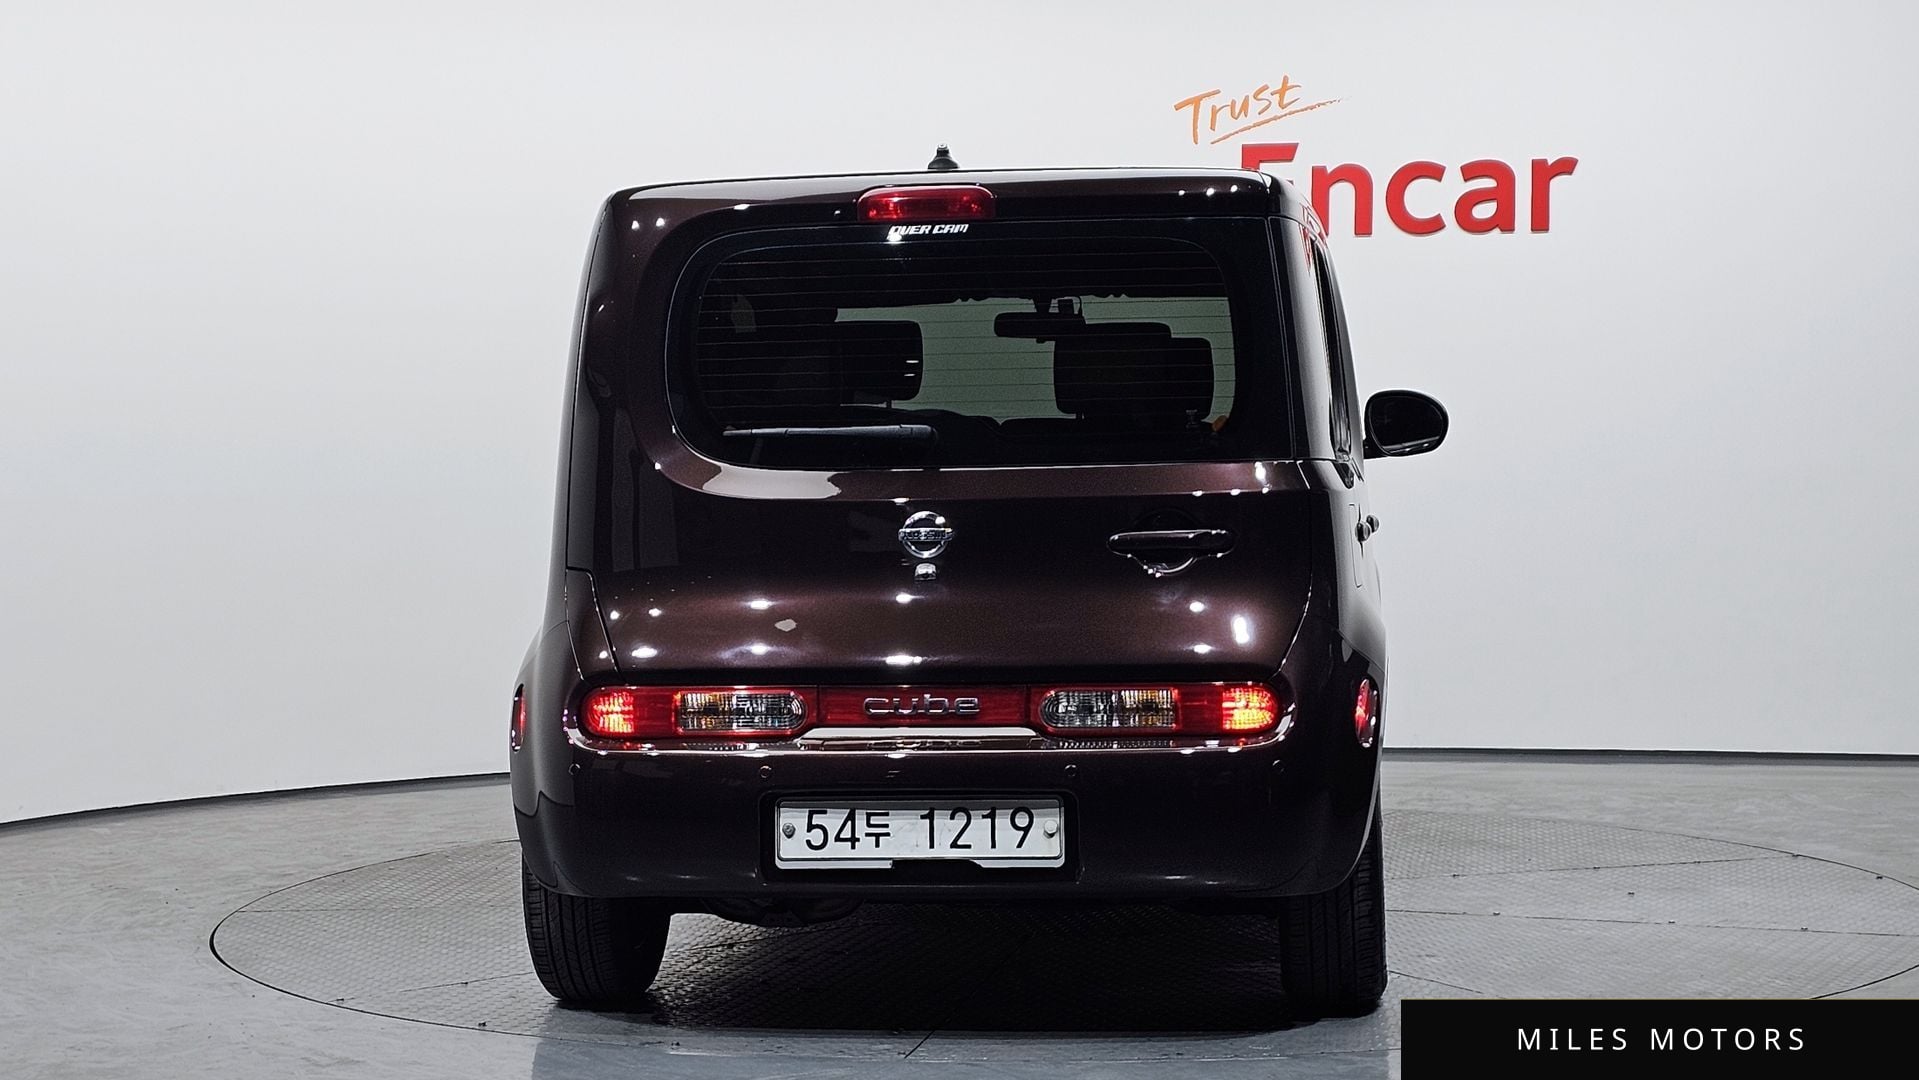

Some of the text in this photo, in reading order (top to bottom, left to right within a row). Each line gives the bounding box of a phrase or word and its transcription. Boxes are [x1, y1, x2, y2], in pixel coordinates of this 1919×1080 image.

[1174, 75, 1302, 145] Trust
[932, 224, 969, 234] CAM
[864, 694, 980, 715] cube
[805, 806, 1035, 851] 54두 1219
